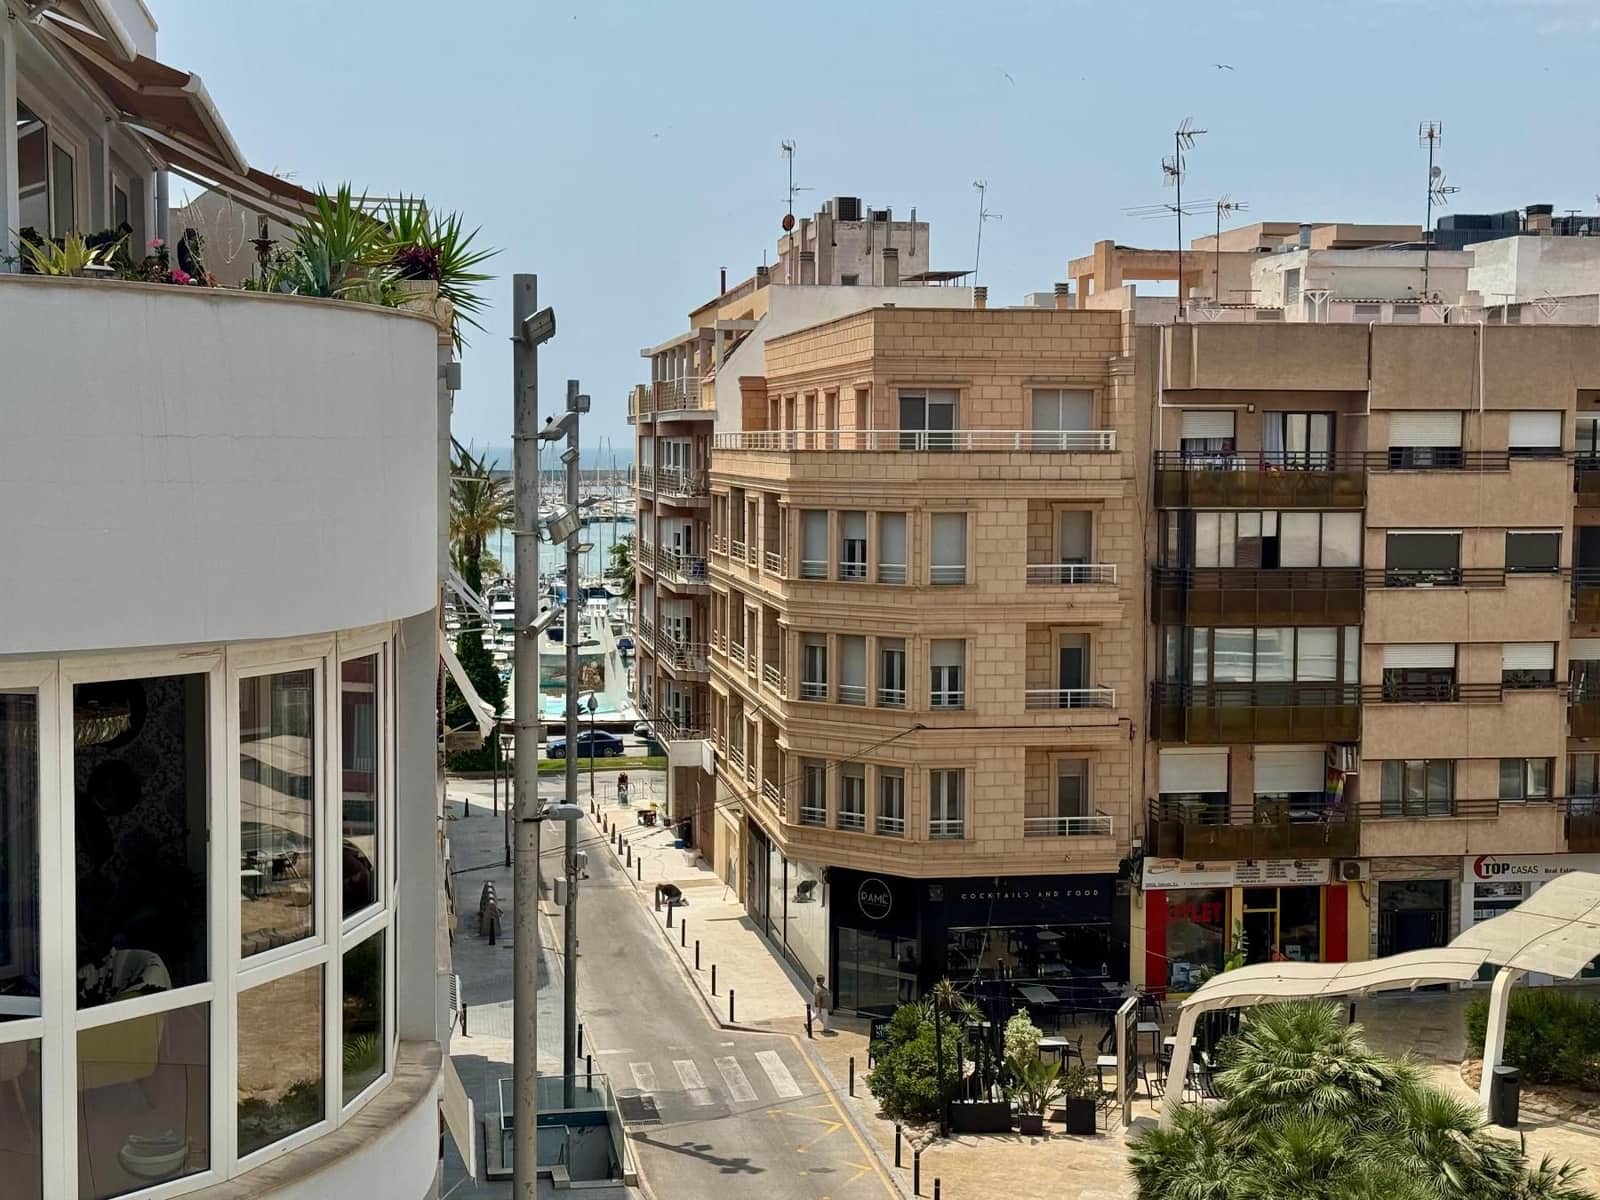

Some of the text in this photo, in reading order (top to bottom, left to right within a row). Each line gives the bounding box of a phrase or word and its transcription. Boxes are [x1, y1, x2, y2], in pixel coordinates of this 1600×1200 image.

[1484, 863, 1510, 874] TOP
[1511, 865, 1539, 874] CASAS
[961, 889, 1099, 900] COCKTAILS AND FOOD
